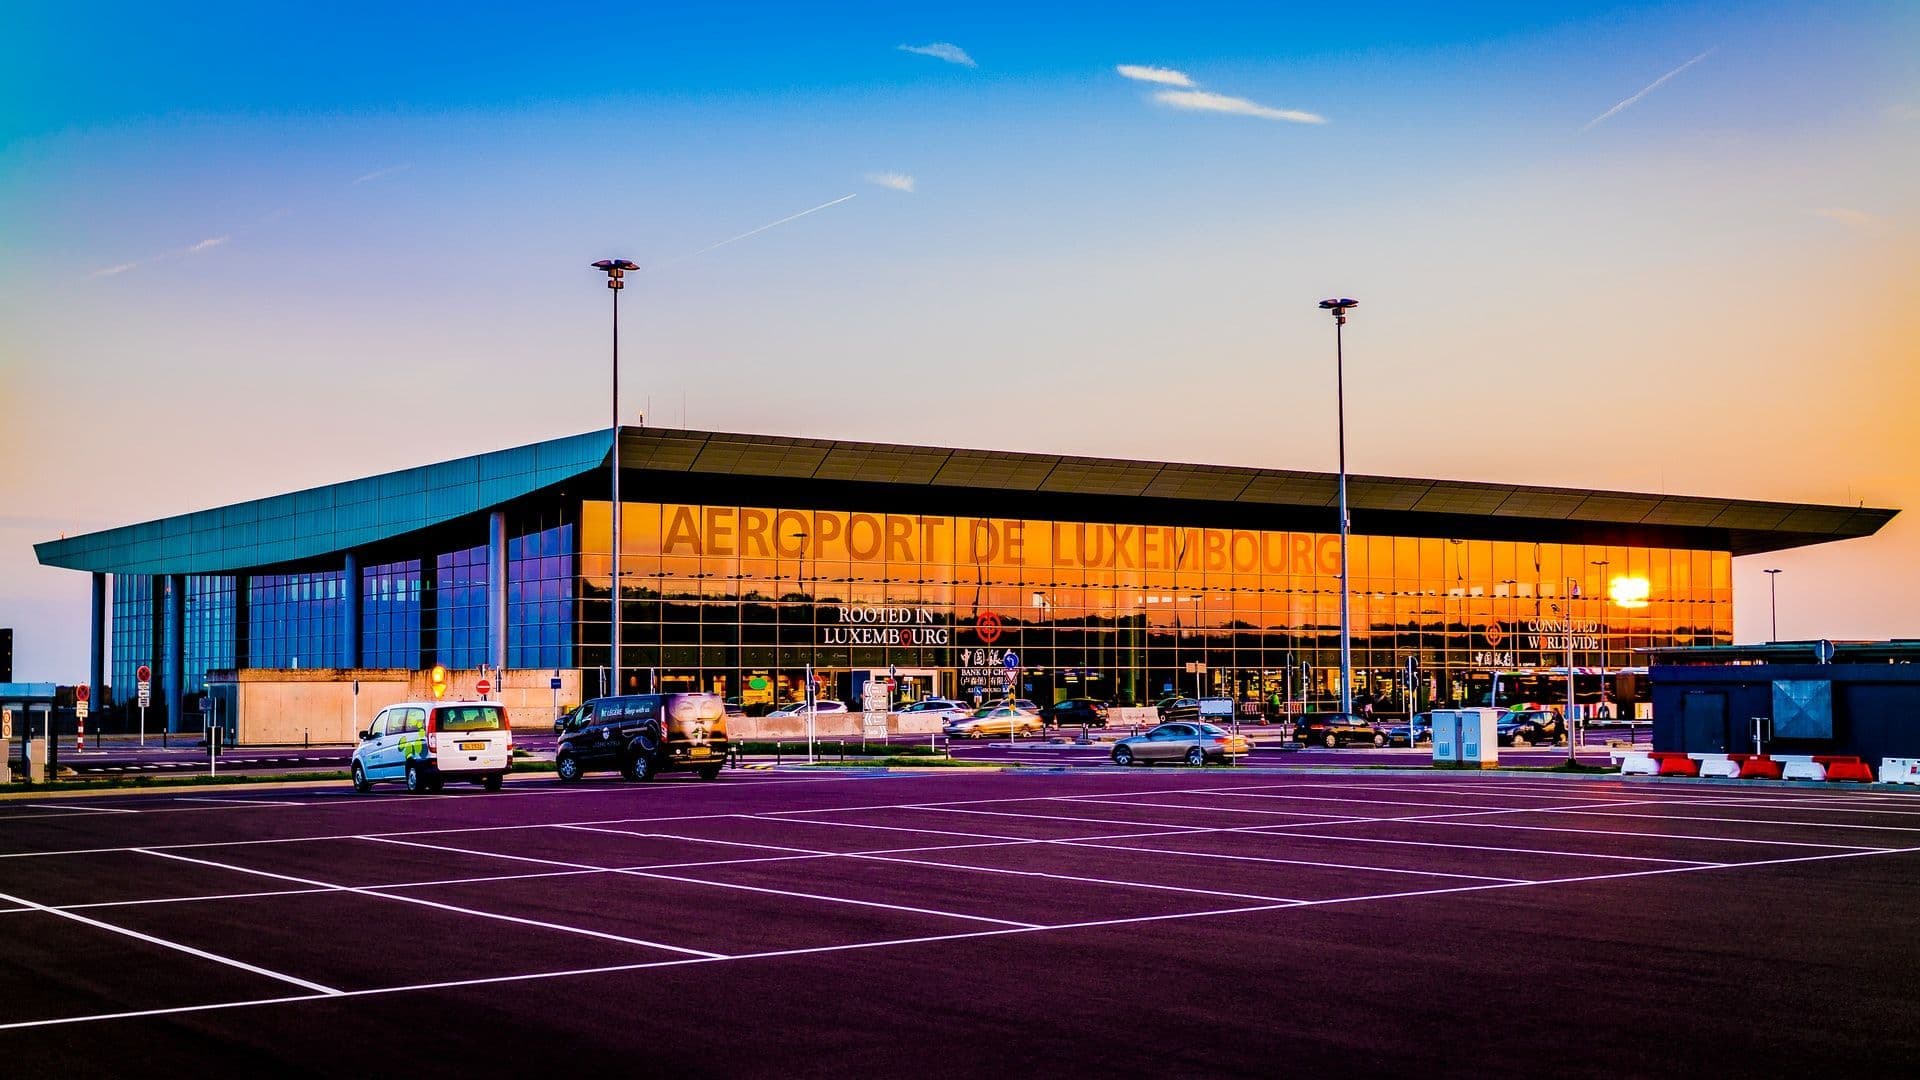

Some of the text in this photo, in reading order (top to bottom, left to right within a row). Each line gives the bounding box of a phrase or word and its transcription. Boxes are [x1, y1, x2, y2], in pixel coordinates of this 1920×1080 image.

[662, 506, 1342, 575] AEROPORT DE LUXEMBOURG
[838, 606, 933, 624] ROOTED IN
[1528, 619, 1597, 633] CONNECTED
[823, 627, 948, 645] LUXEMBOURG
[1528, 636, 1599, 649] WORLDWIDE
